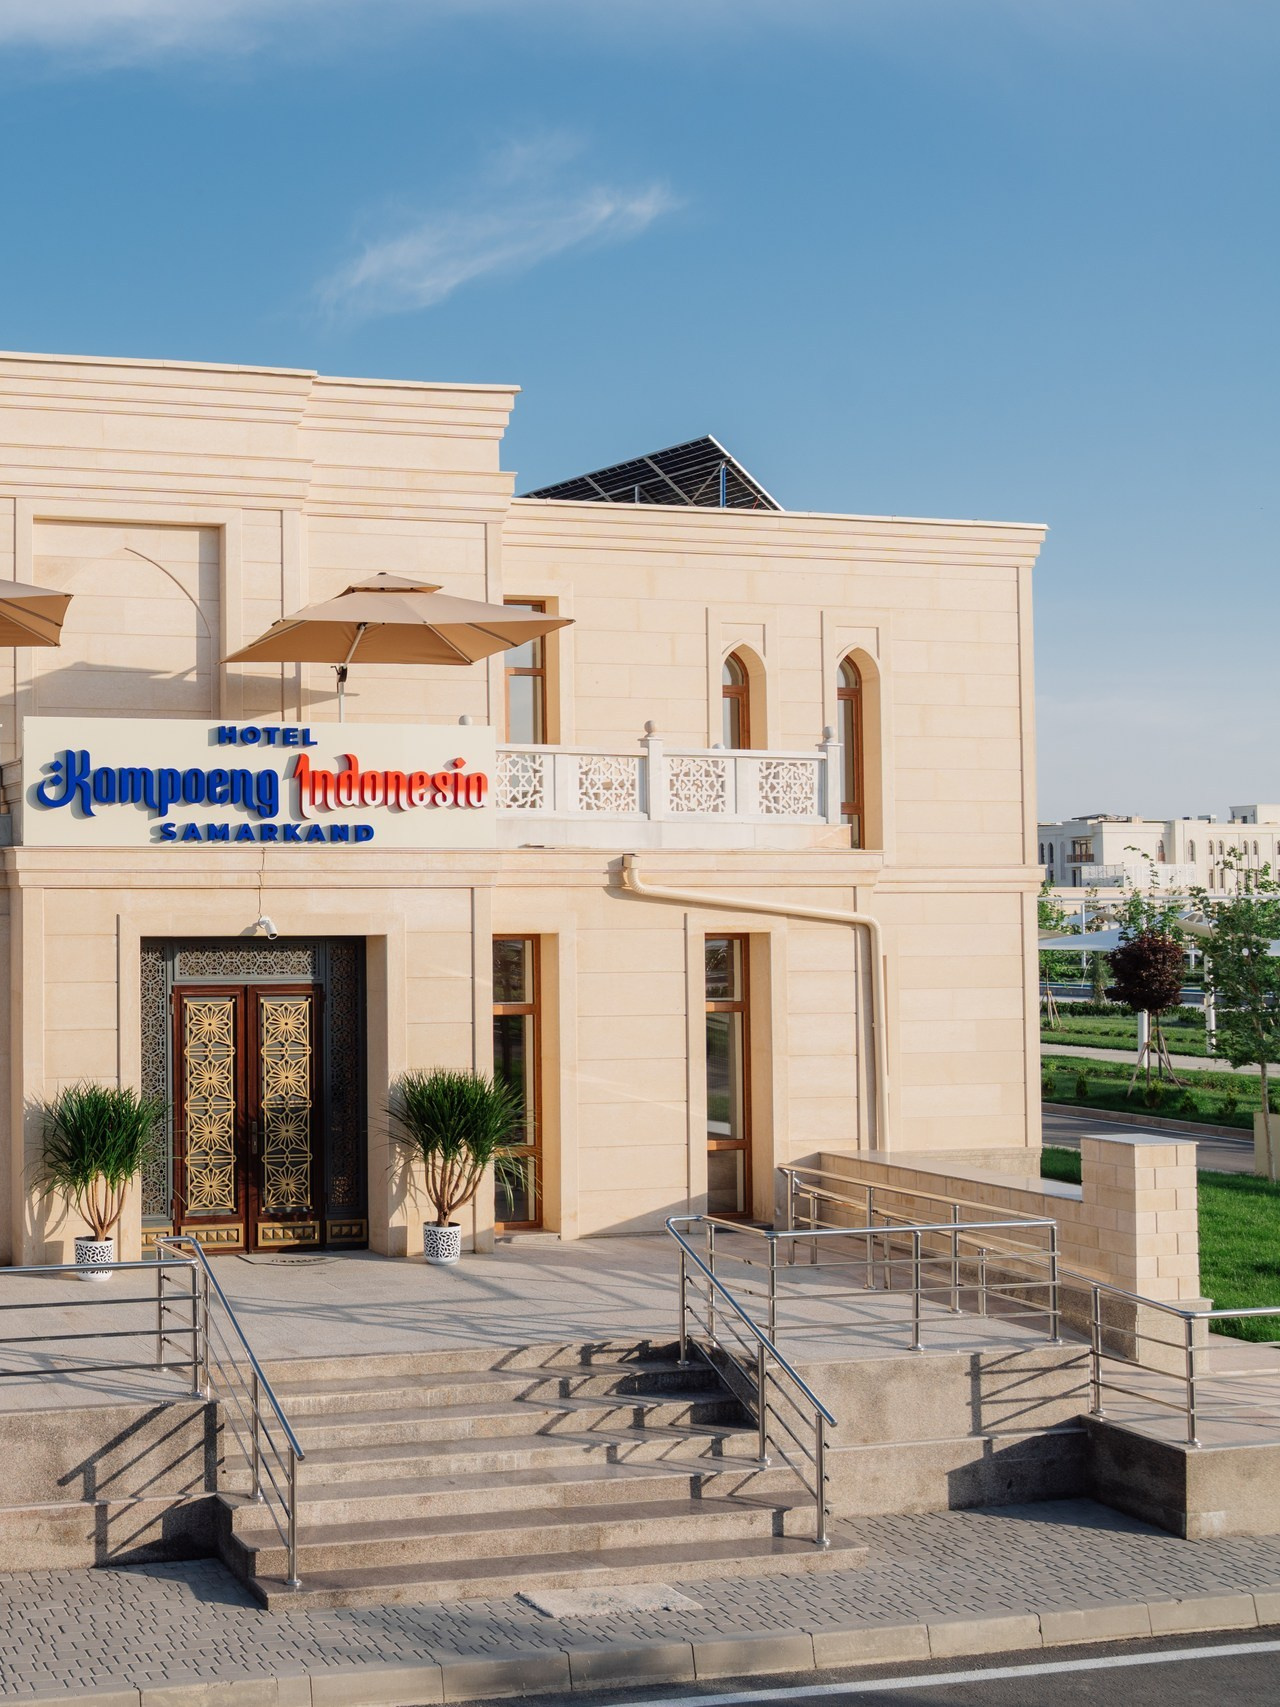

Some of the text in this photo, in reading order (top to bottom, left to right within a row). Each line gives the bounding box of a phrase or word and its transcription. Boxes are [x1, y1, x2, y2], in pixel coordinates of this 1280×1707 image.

[218, 726, 318, 745] HOTEL
[37, 749, 489, 819] Kampoeng Indonesia
[160, 822, 374, 843] SAMARKAND
